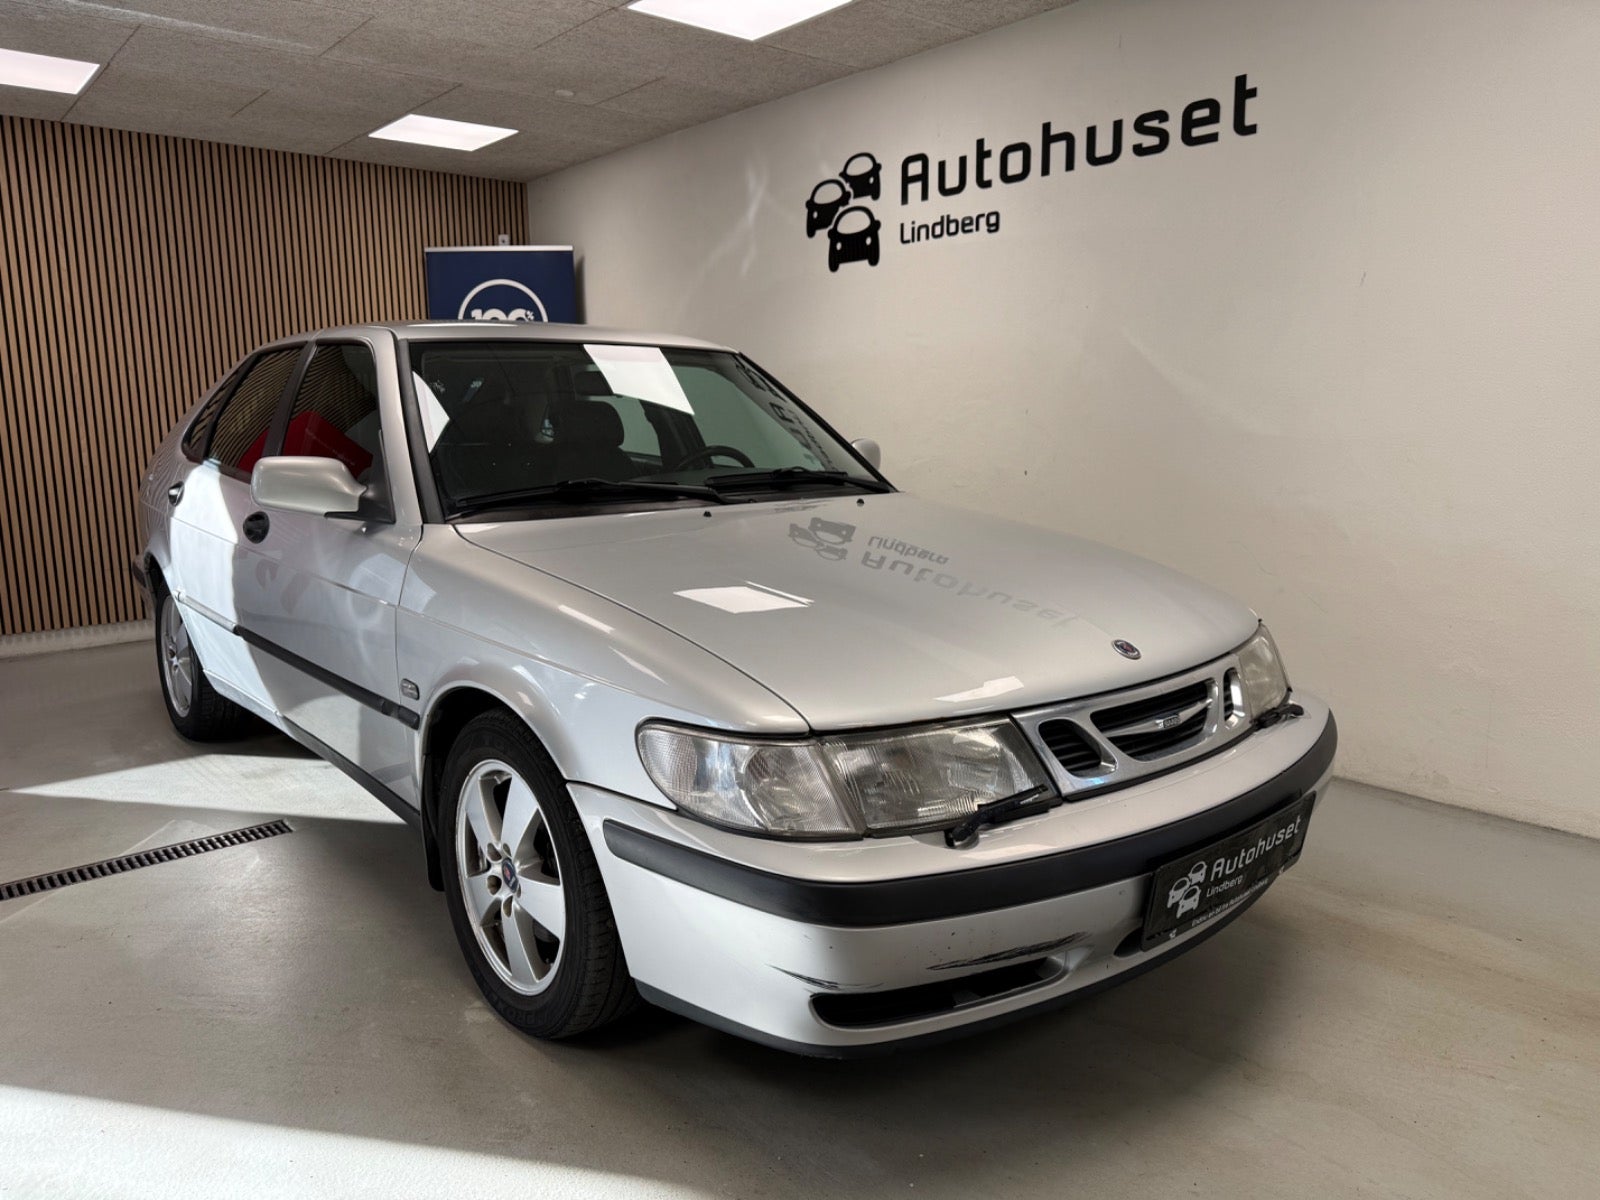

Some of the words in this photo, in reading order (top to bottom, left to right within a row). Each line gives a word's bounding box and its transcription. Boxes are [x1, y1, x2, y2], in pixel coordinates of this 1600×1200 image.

[901, 73, 1258, 205] Autohuset
[900, 210, 1000, 244] Lindberg
[1210, 814, 1301, 882] Autohuset
